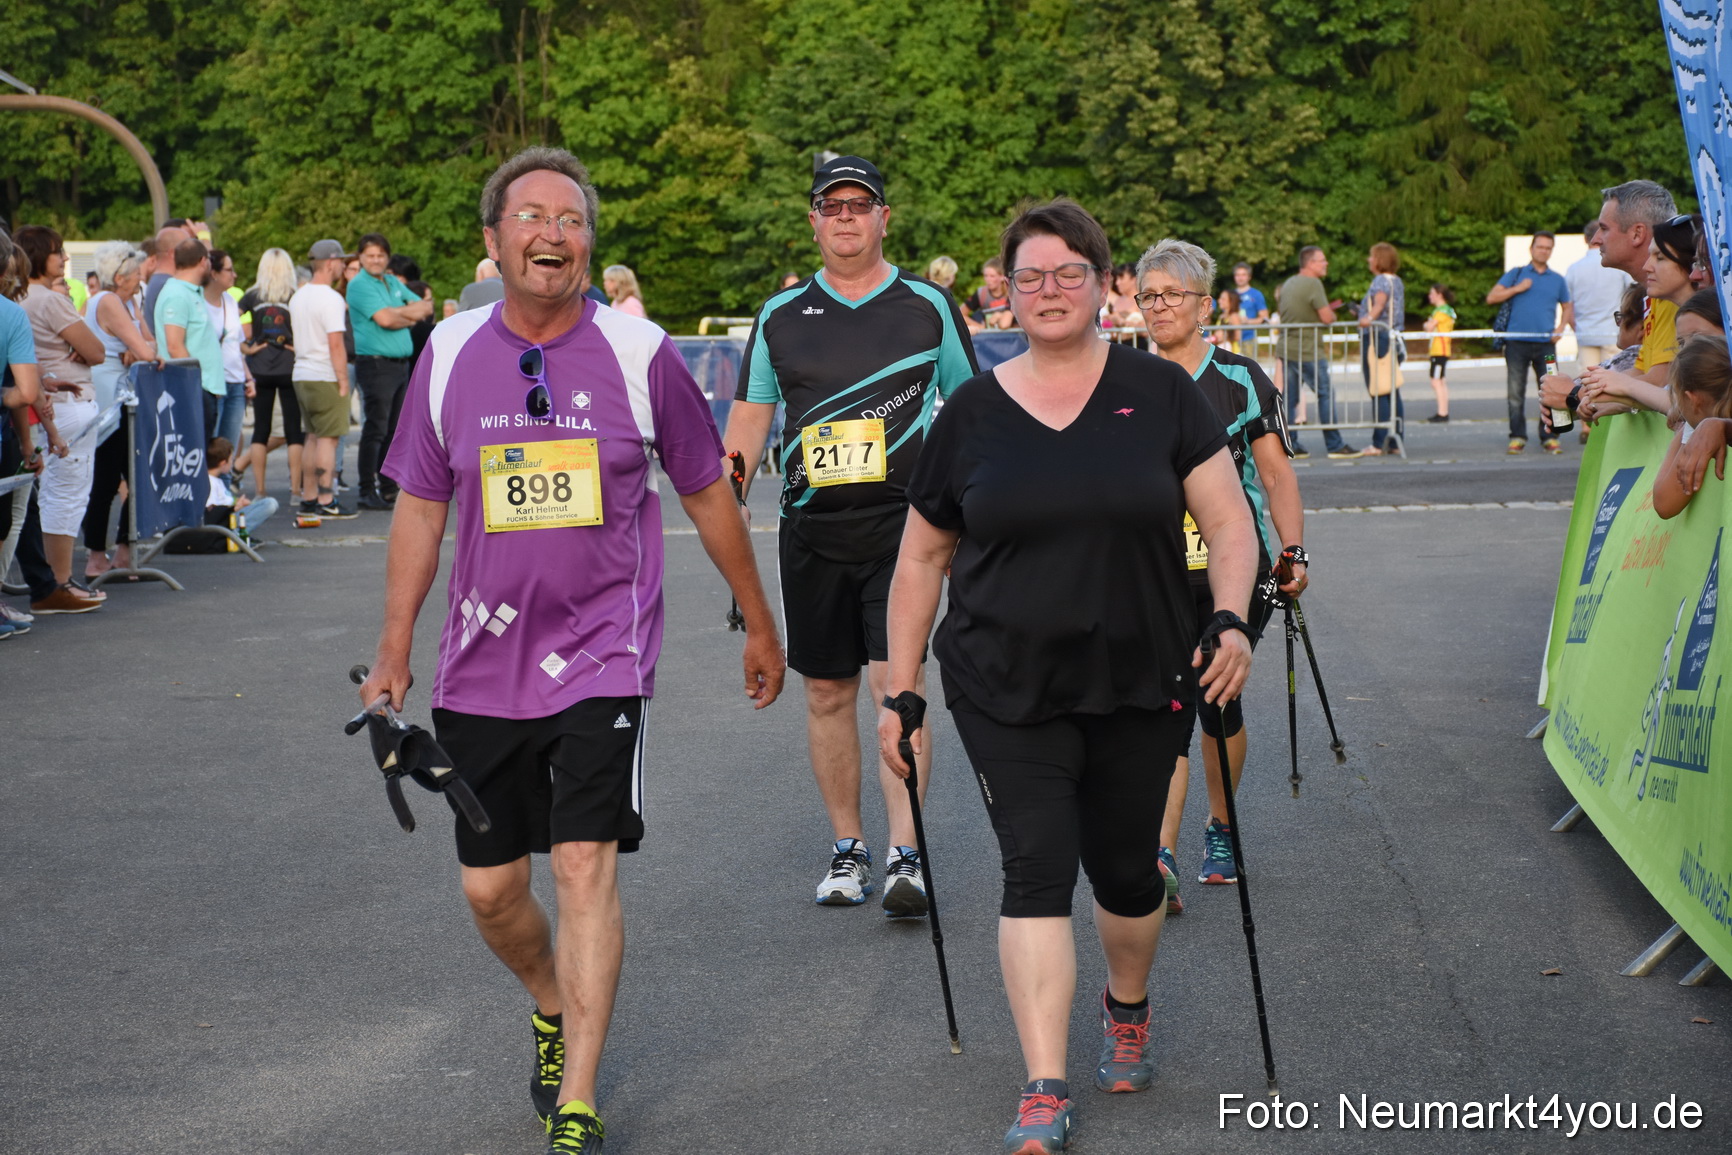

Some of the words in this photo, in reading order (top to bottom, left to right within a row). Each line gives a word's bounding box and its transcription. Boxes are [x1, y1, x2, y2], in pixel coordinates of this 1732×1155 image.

[861, 381, 923, 421] Donauer
[480, 415, 509, 429] WIR
[555, 414, 597, 431] LILA.
[812, 441, 874, 470] 2177
[497, 458, 543, 471] firmenlauf
[821, 467, 848, 475] Donauer
[506, 472, 573, 506] 898
[515, 506, 534, 515] Karl
[536, 505, 568, 513] Helmut
[506, 515, 528, 523] FUCHS
